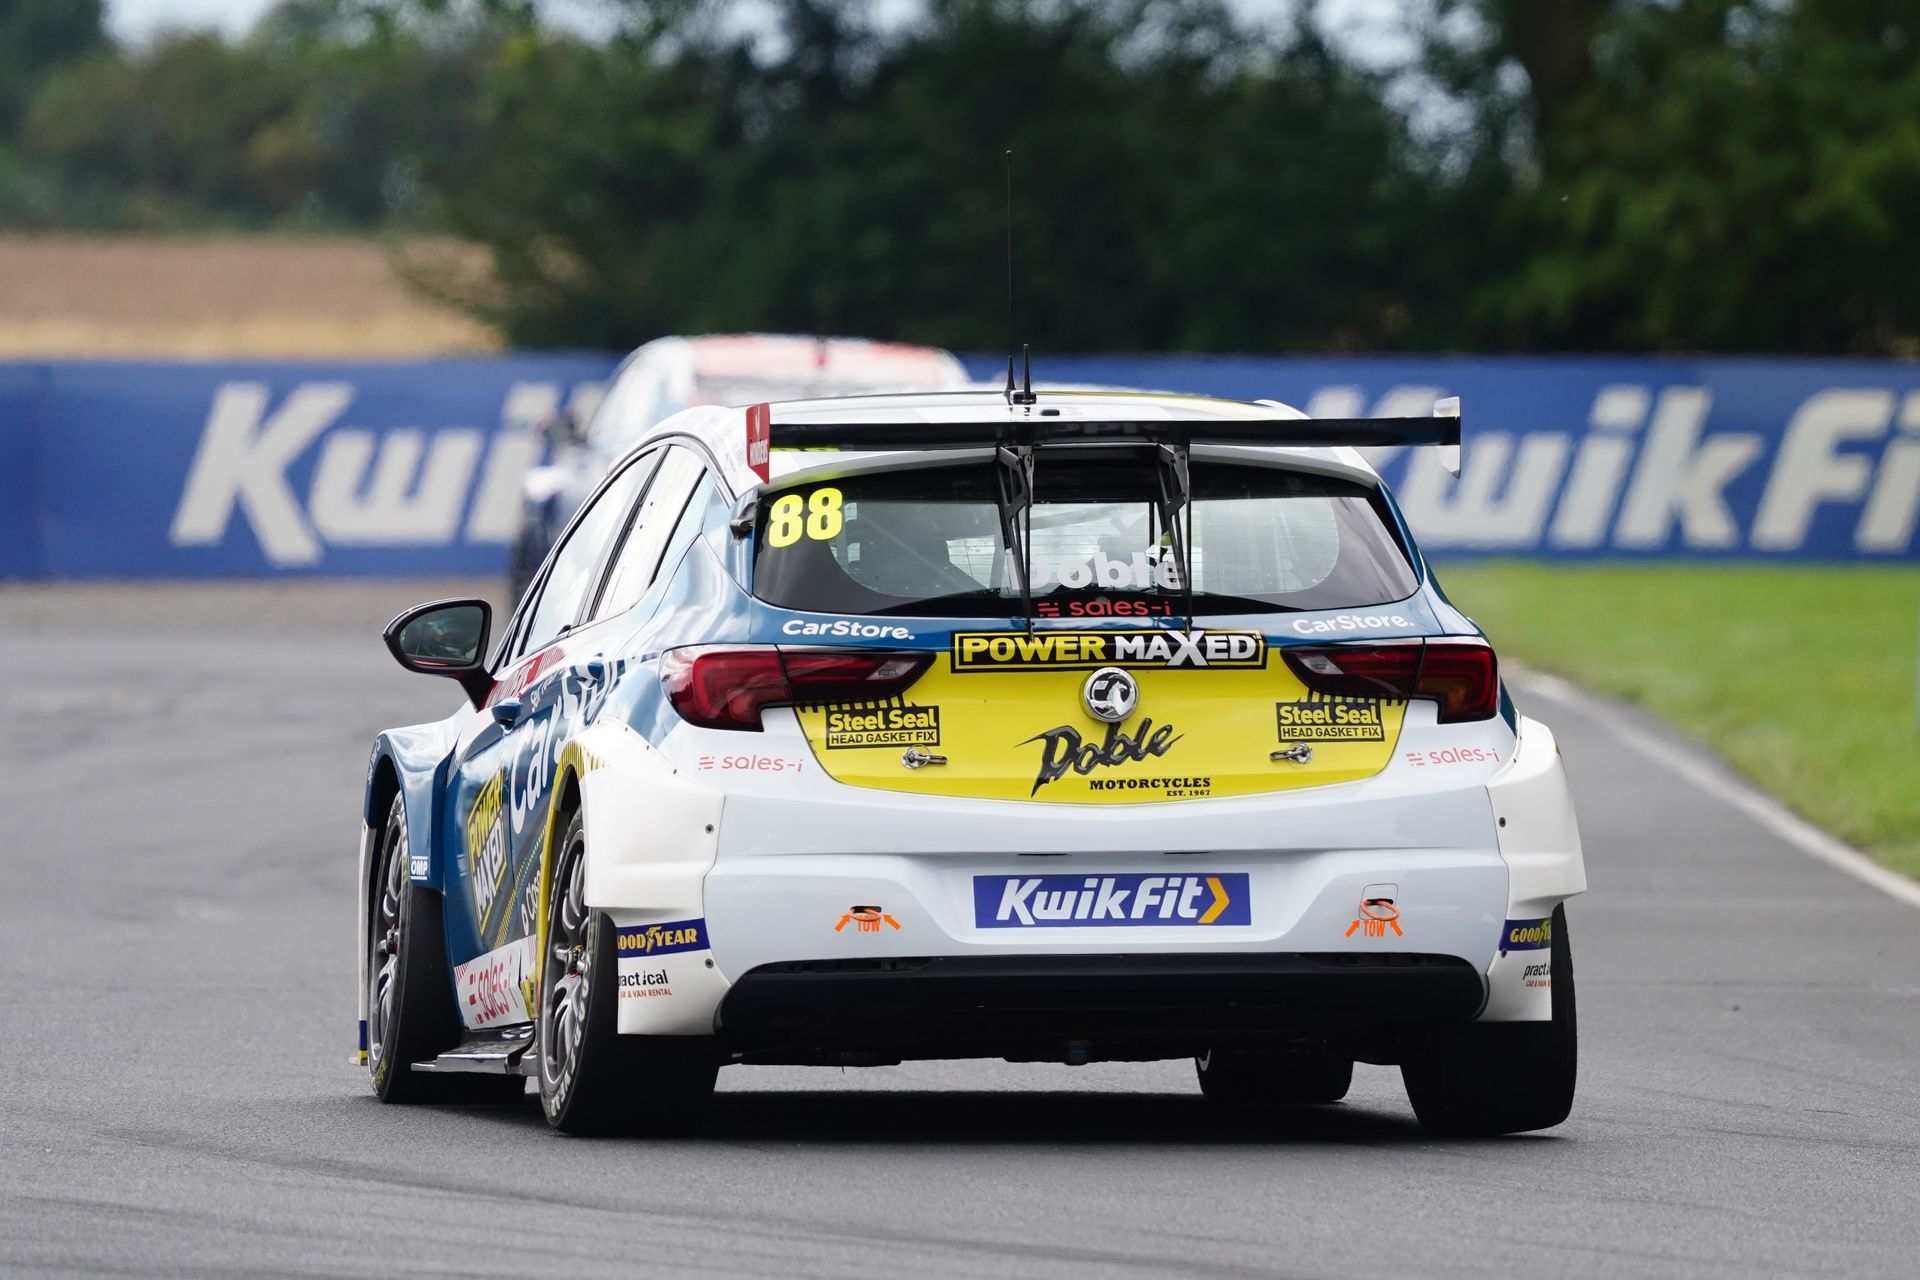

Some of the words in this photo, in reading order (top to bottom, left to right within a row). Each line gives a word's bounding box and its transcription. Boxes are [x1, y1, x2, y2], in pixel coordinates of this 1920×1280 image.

[768, 487, 843, 548] 88
[1069, 601, 1173, 616] sales-i
[963, 635, 1106, 662] POWER
[1114, 630, 1256, 666] MAXED
[829, 710, 886, 732] Steel
[888, 708, 937, 730] Seal
[1280, 705, 1333, 724] Steel
[1335, 704, 1379, 724] Seal
[831, 734, 864, 744] HEAD
[866, 732, 914, 743] GASKET
[916, 731, 935, 741] FIX
[1282, 728, 1313, 737] HEAD
[1315, 727, 1359, 737] GASKET
[1362, 727, 1380, 736] FIX
[721, 754, 803, 772] sales-i
[1014, 718, 1185, 798] Doble
[1428, 747, 1499, 765] sales-i
[1089, 777, 1211, 791] MOTORCYCLES
[469, 768, 503, 868] POWER
[410, 860, 429, 876] OMP
[856, 915, 881, 932] TOW
[1364, 919, 1386, 937] TOW
[617, 927, 698, 951] OODYEAR
[618, 969, 669, 987] actical
[633, 990, 647, 998] VAN
[648, 988, 672, 997] RENTAL
